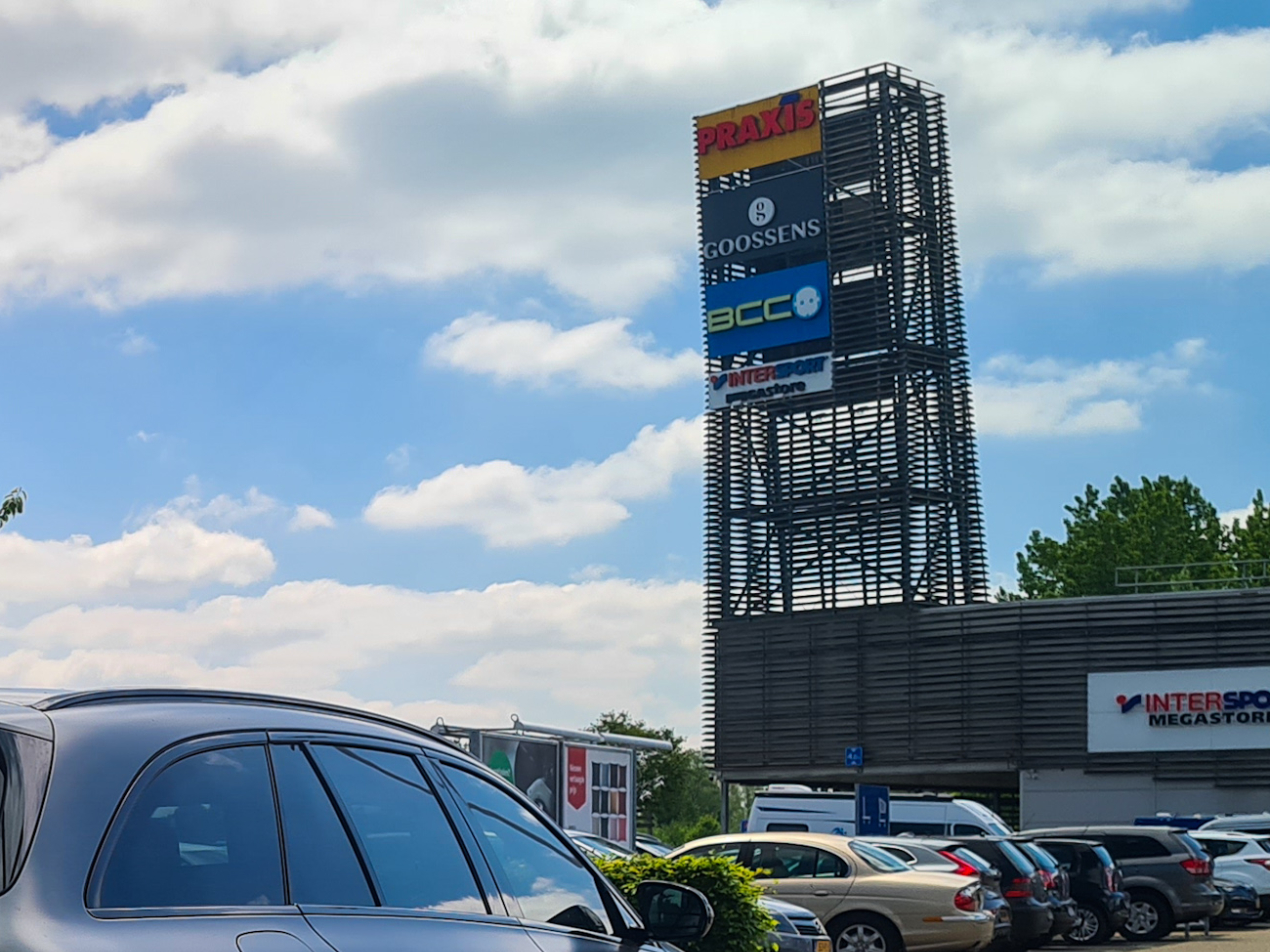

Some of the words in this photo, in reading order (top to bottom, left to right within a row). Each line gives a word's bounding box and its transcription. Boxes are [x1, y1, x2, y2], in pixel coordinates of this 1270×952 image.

[698, 99, 815, 155] PRAXIS
[703, 218, 821, 260] GOOSSENS
[707, 294, 793, 333] BCC
[727, 357, 829, 388] INTERSPORT
[1148, 711, 1270, 727] MEGASTOR
